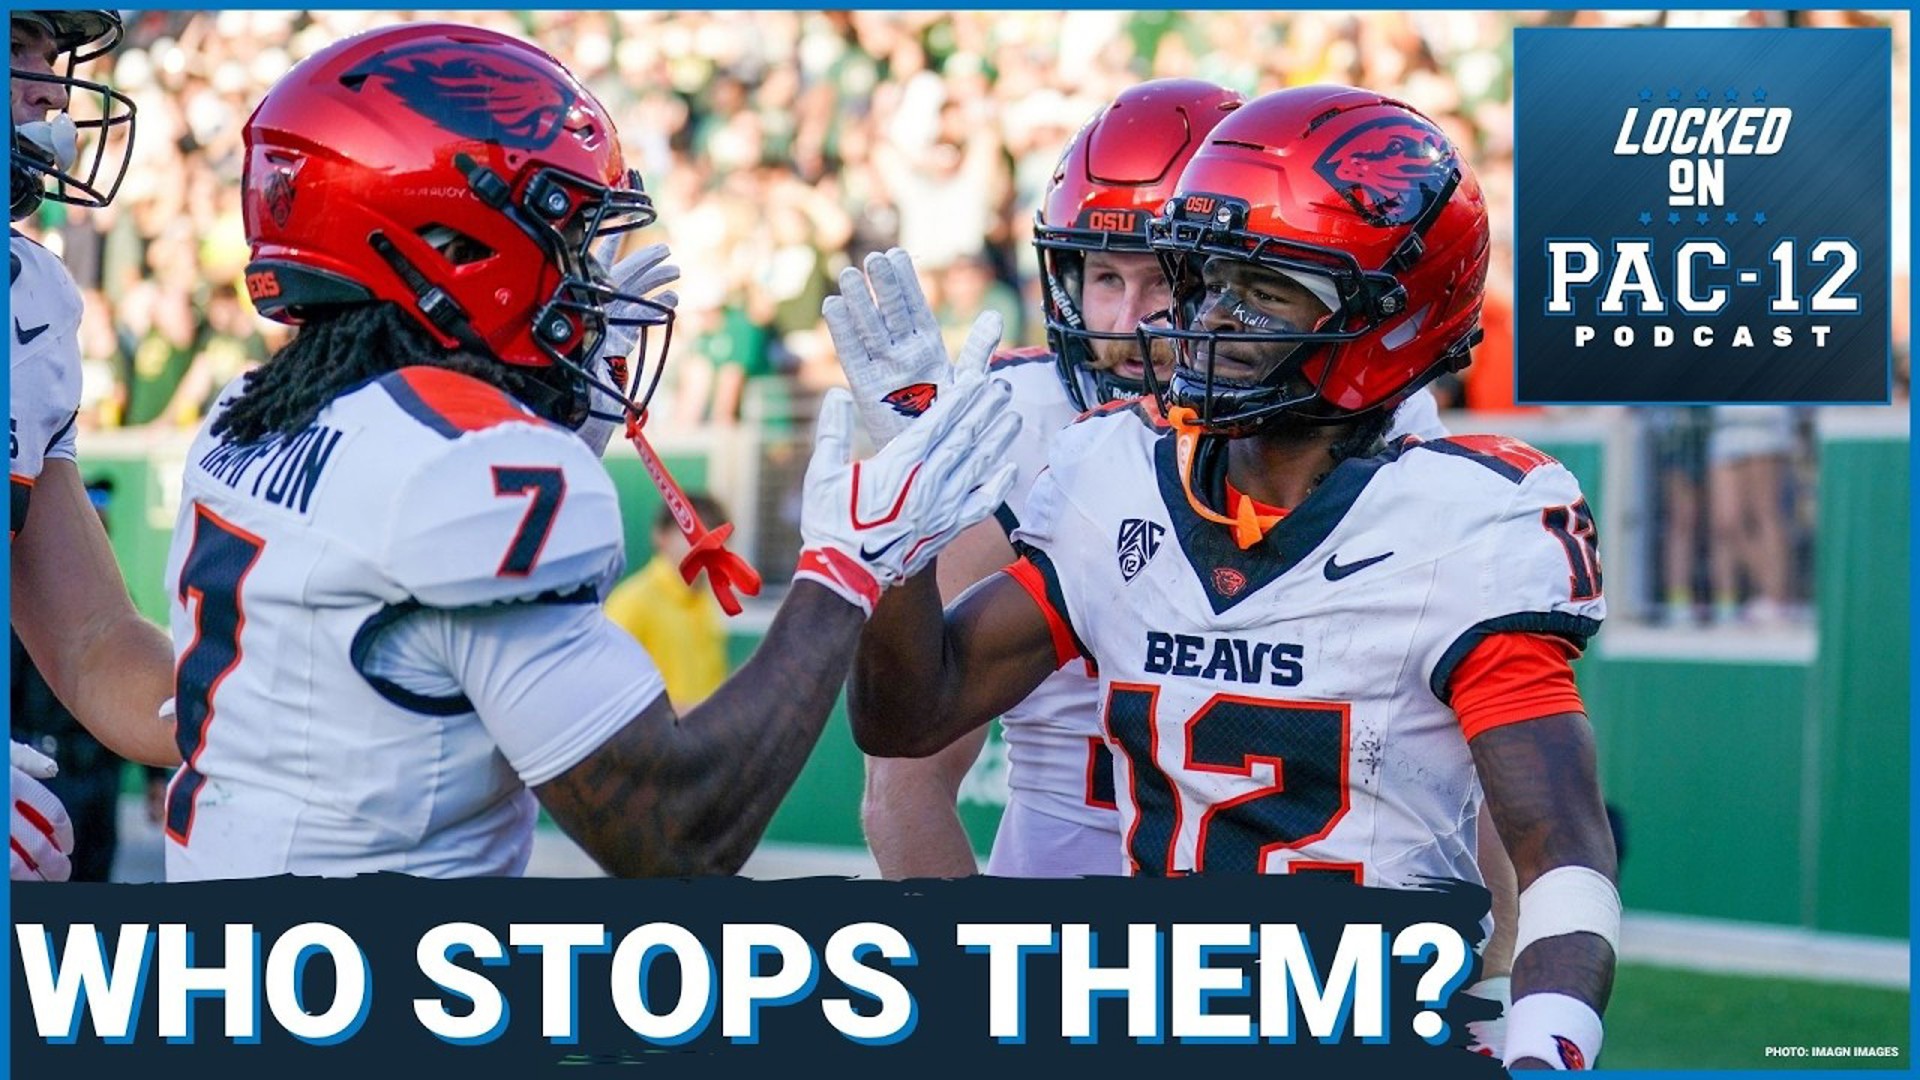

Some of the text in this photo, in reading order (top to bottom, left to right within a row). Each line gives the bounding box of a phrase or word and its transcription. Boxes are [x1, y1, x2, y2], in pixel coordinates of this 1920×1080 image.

[1088, 211, 1135, 233] OSU
[1184, 195, 1215, 214] OSU
[490, 465, 567, 577] 7
[1117, 518, 1166, 560] PAC
[1123, 558, 1138, 573] 12
[165, 501, 266, 847] 7
[1144, 630, 1304, 688] BEAVS
[1104, 680, 1364, 888] 12
